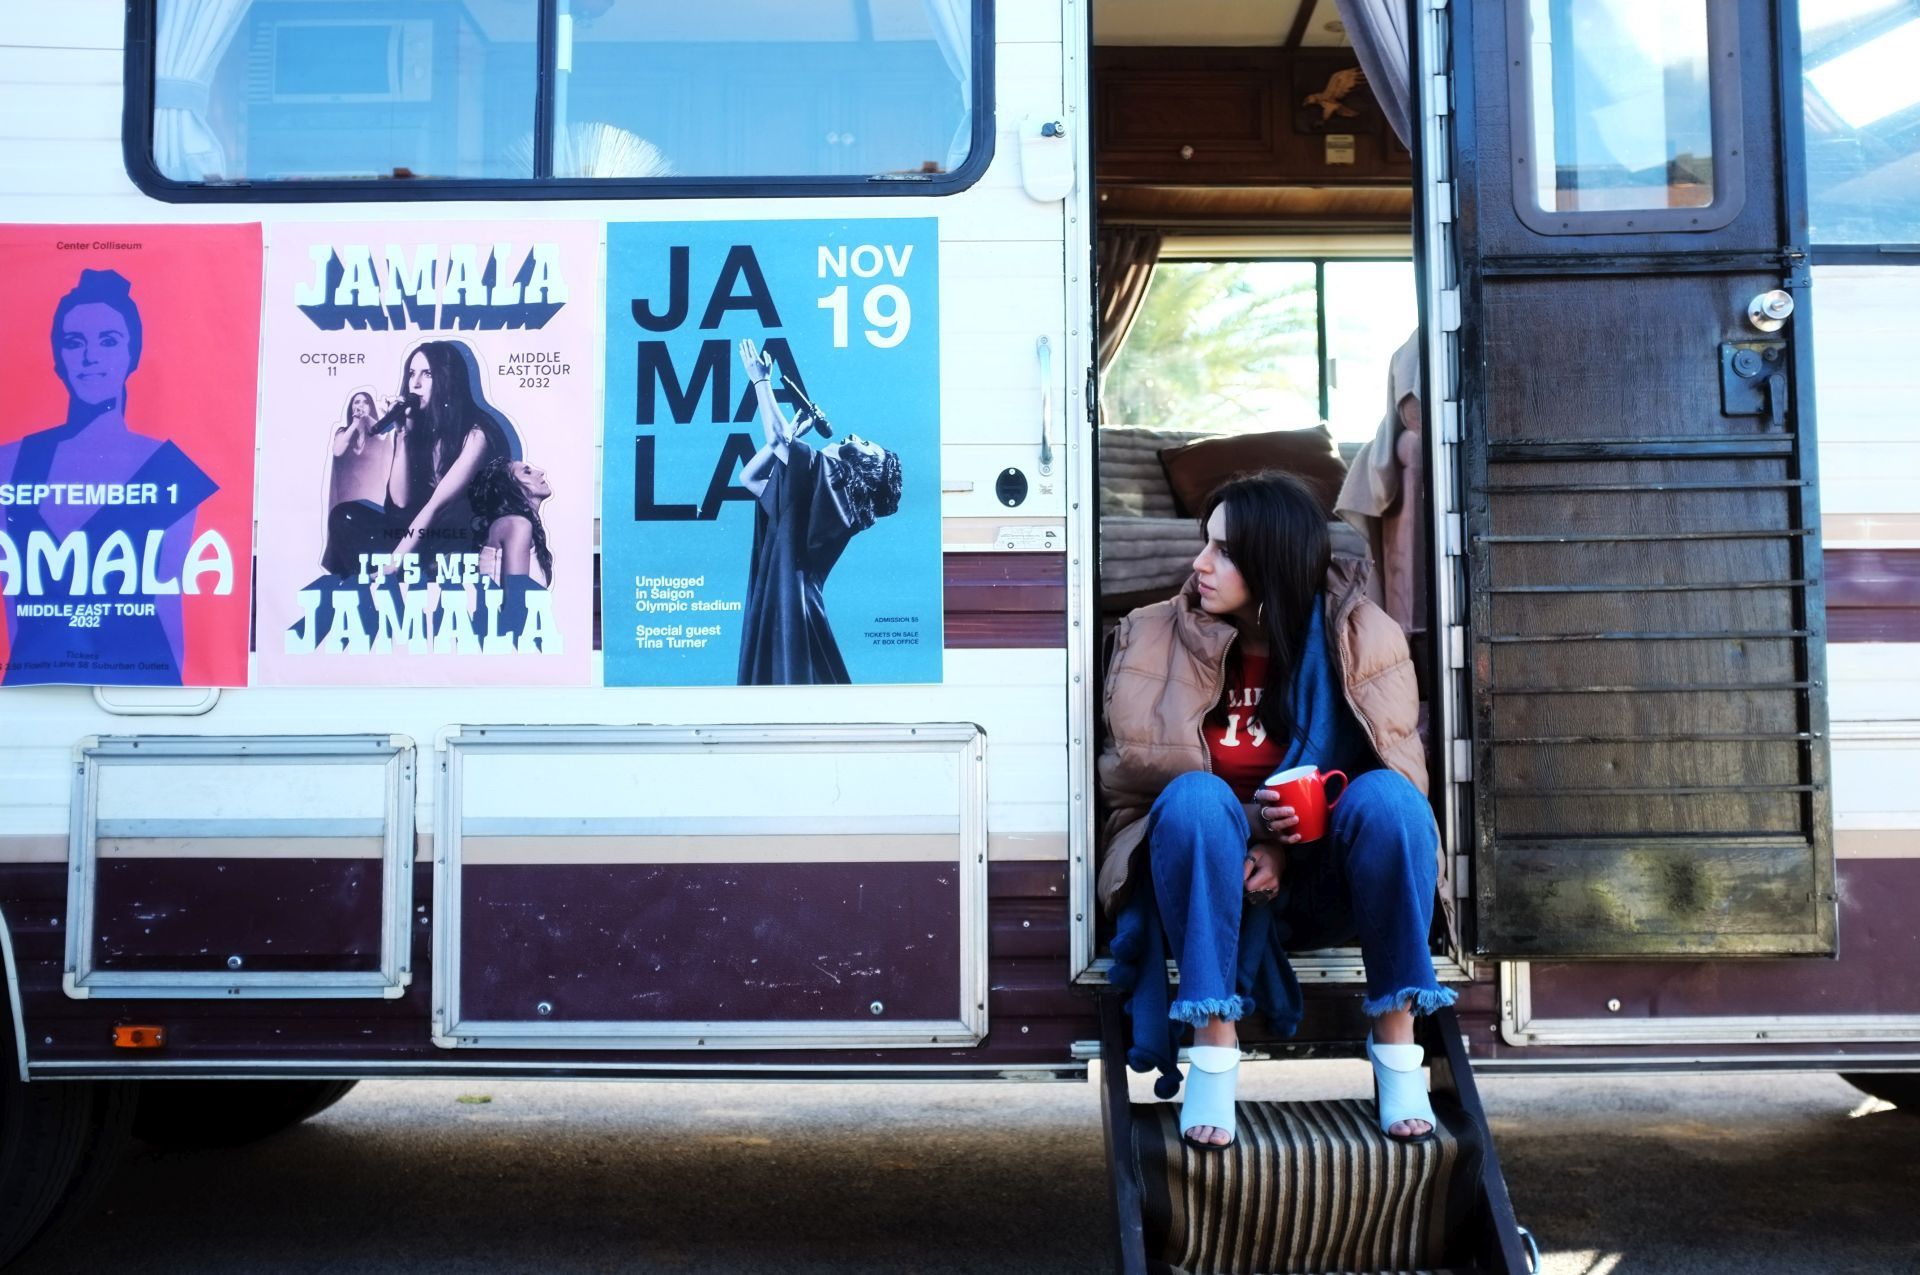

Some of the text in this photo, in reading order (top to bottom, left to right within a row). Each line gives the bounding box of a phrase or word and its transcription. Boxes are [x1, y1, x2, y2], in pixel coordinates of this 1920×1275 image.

[56, 241, 90, 250] Center
[817, 244, 914, 278] NOV
[294, 242, 569, 306] JAMALA
[631, 245, 783, 333] JA
[817, 283, 912, 349] 19
[300, 353, 366, 365] OCTOBER
[508, 351, 561, 364] MIDDLE
[327, 366, 338, 377] 11
[498, 364, 571, 376] EAST TOUR
[519, 377, 550, 389] 2032
[0, 483, 178, 506] SEPTEMBER 1
[383, 528, 467, 540] NEW SINGLE
[358, 552, 491, 590] IT'S ME,
[635, 575, 705, 589] Unplugged
[635, 588, 695, 601] in Saigon
[16, 603, 156, 617] MIDDLE EAST TOUR
[635, 600, 742, 614] Olympic stadium
[68, 615, 100, 628] 2032
[283, 589, 565, 656] JAMALA
[635, 624, 722, 638] Special guest
[635, 636, 708, 649] Tina Turner
